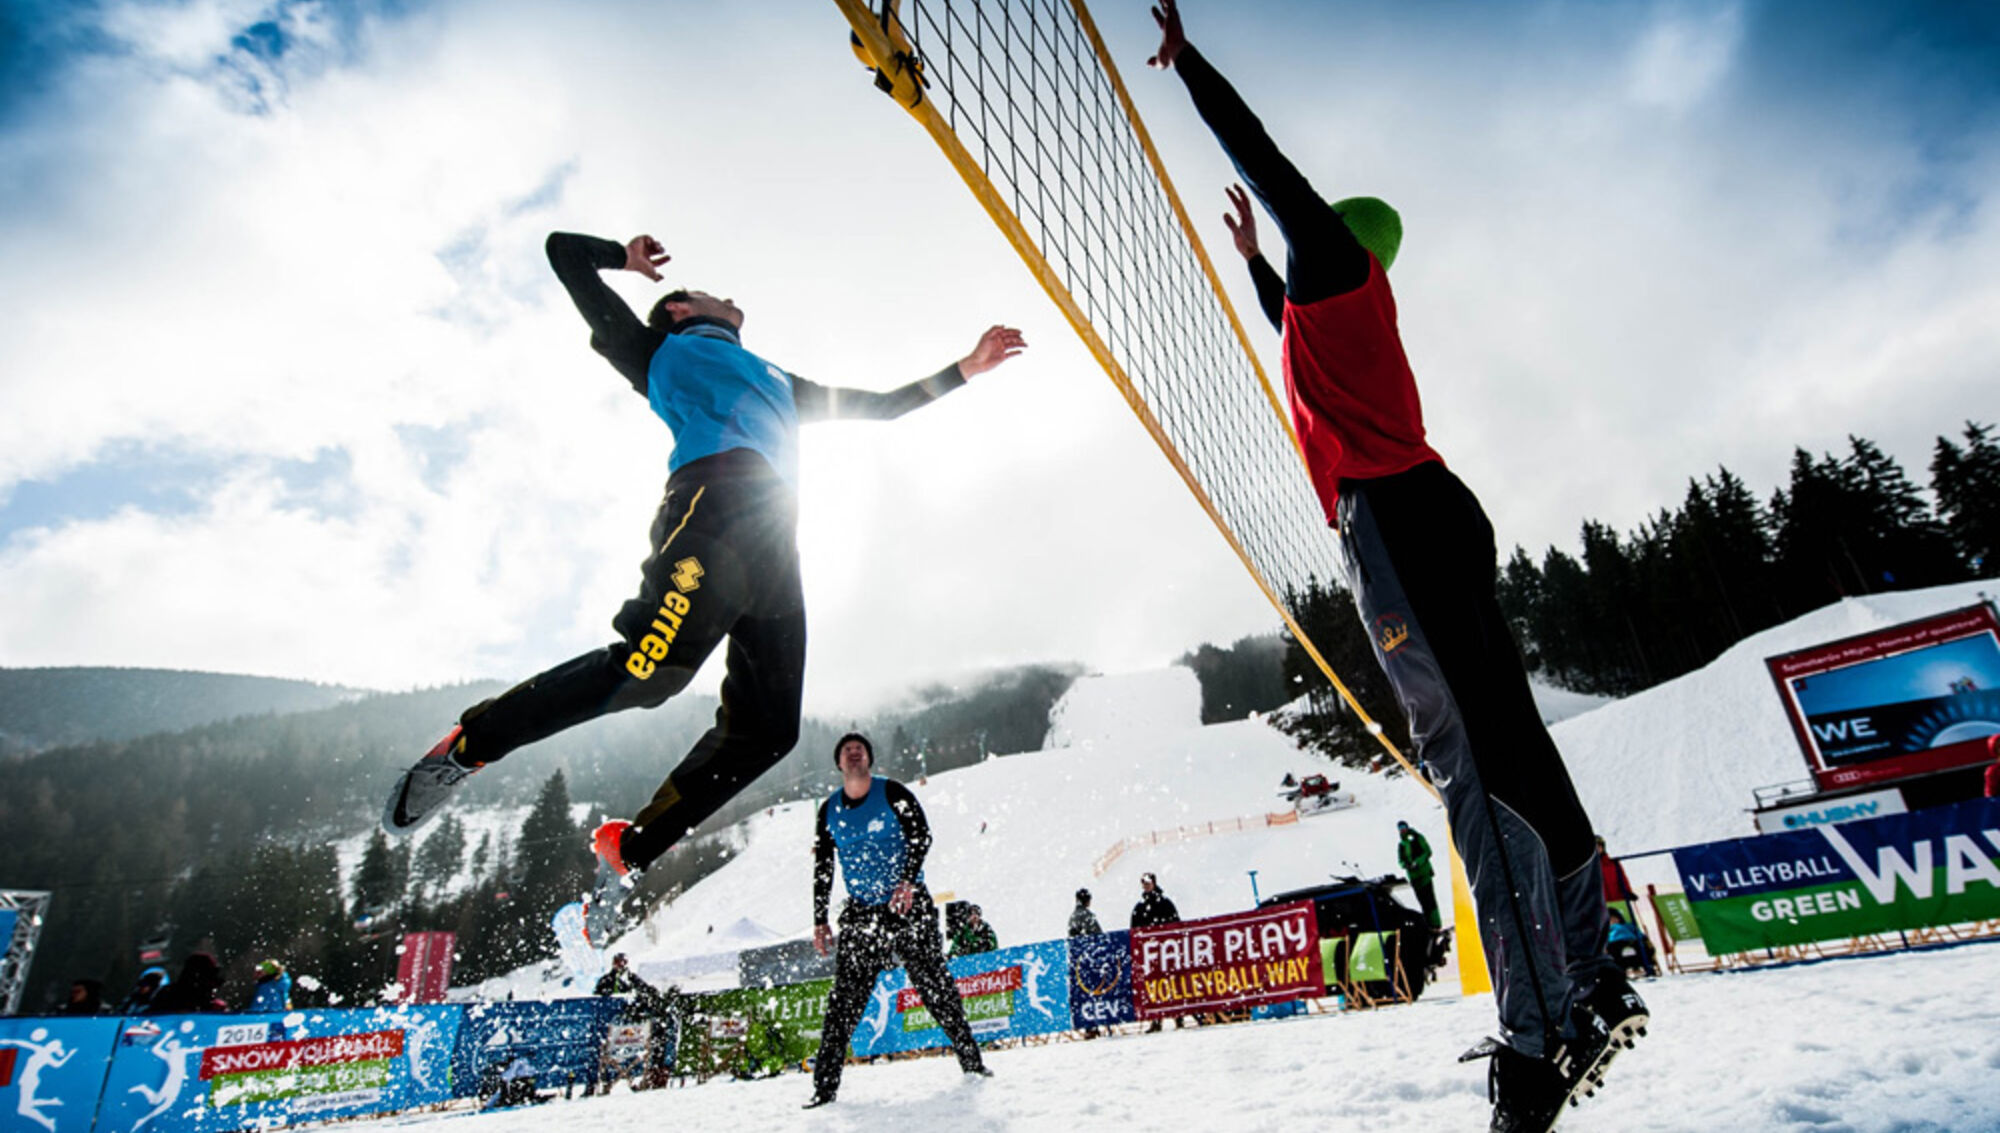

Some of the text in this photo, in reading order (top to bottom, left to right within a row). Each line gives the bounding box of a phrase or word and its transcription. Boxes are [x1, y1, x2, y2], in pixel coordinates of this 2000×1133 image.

[1813, 717, 1877, 741] WE
[1751, 888, 1862, 922] GREEN
[1816, 824, 2000, 905] WA
[1142, 917, 1308, 976] FAIR PLAY
[1145, 956, 1310, 1003] VOLLEYBALL WAY
[1081, 1000, 1119, 1020] CEV
[223, 1028, 264, 1044] 2016
[212, 1049, 284, 1072] SNOW
